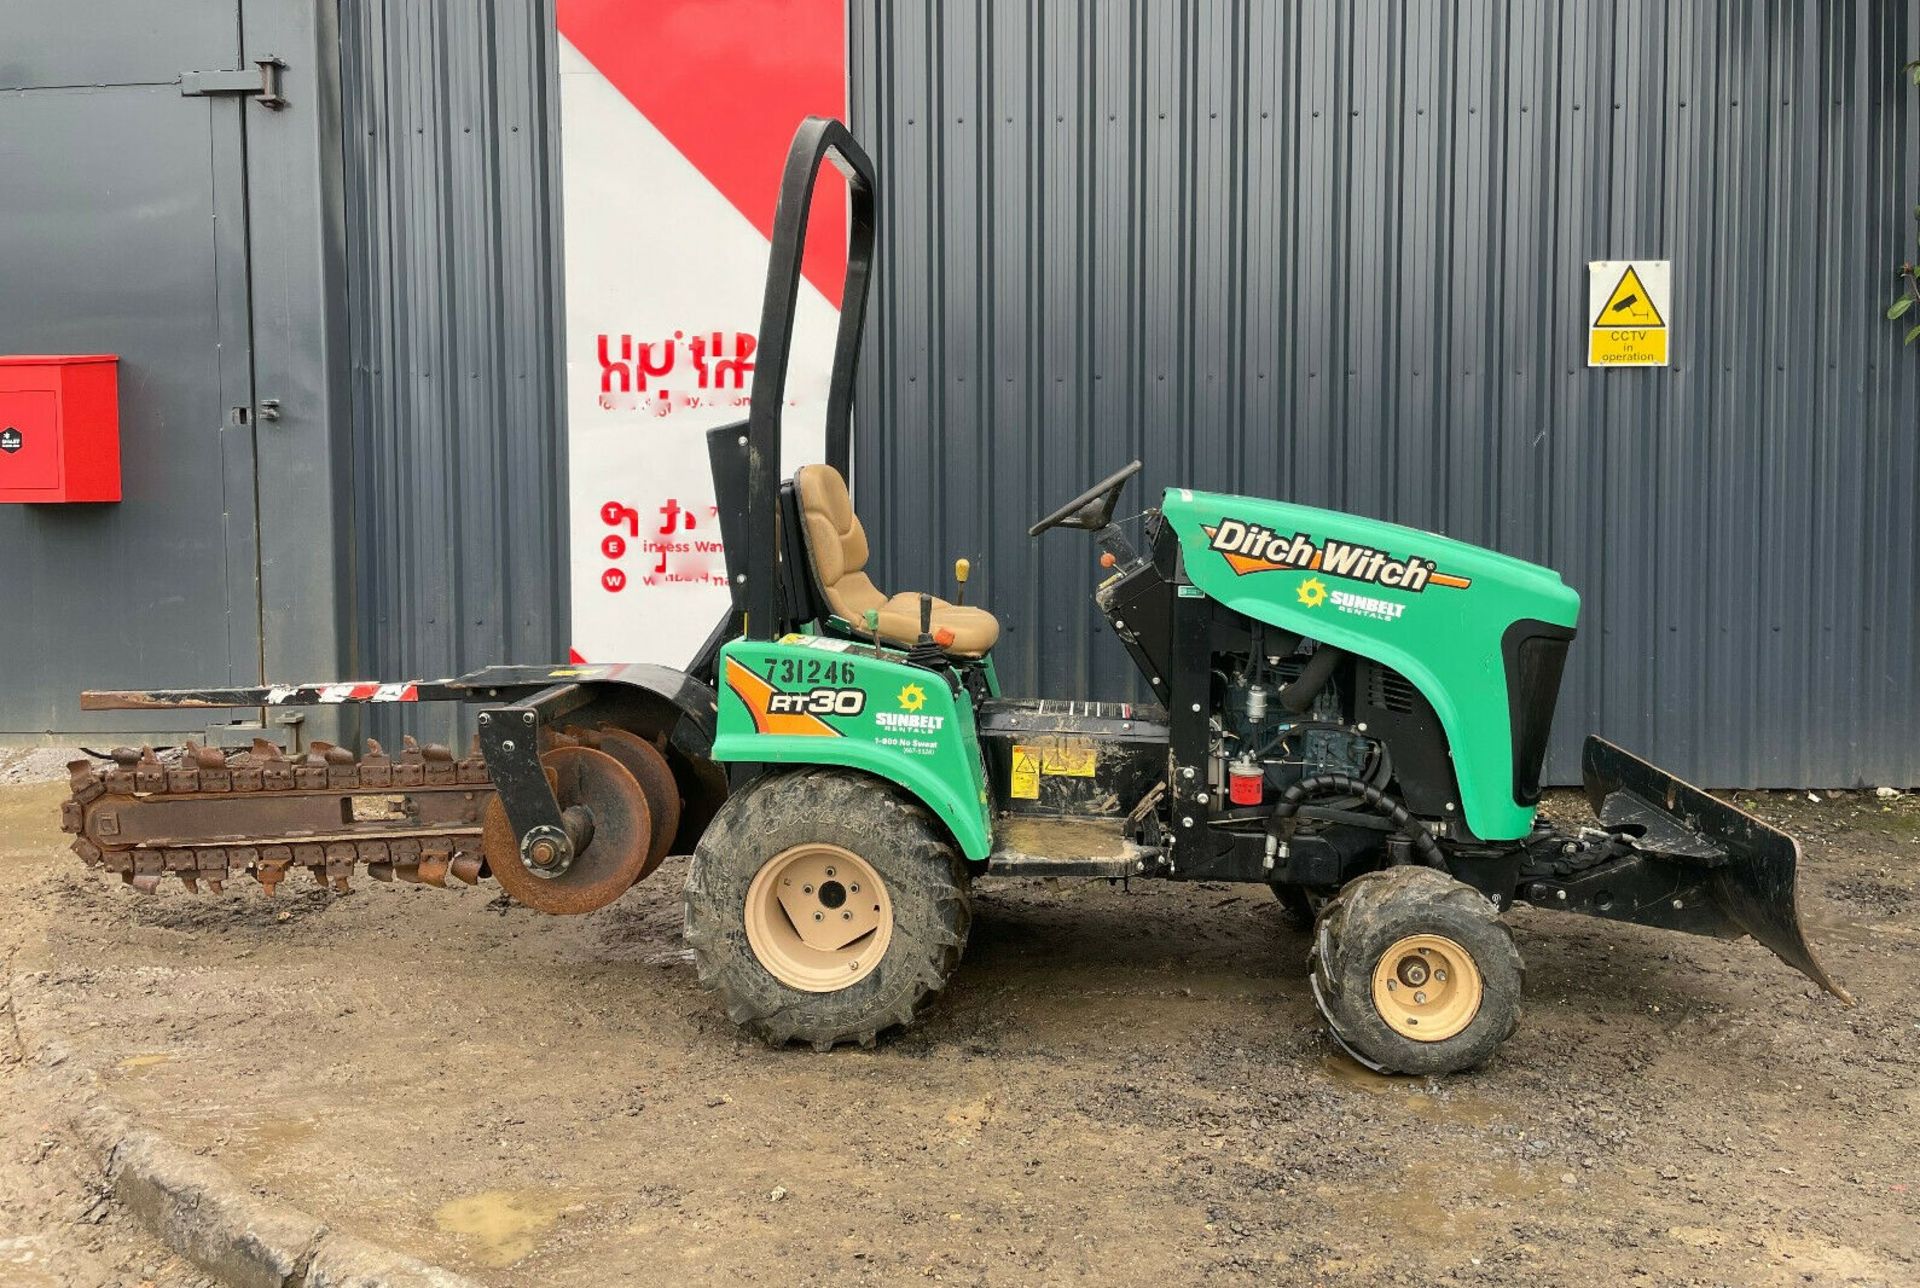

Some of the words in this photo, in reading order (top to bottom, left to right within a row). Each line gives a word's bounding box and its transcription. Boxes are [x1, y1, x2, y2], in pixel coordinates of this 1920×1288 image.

[1611, 331, 1647, 341] CCTV
[1623, 343, 1634, 352] in
[1602, 353, 1655, 363] operation
[1211, 518, 1316, 568] Ditch
[1330, 590, 1406, 618] SUNBELT
[1338, 605, 1392, 622] RENTALS
[764, 658, 856, 685] 731246
[770, 689, 864, 714] RT30
[875, 712, 944, 729] SUNBELT
[884, 725, 934, 734] RENTALS
